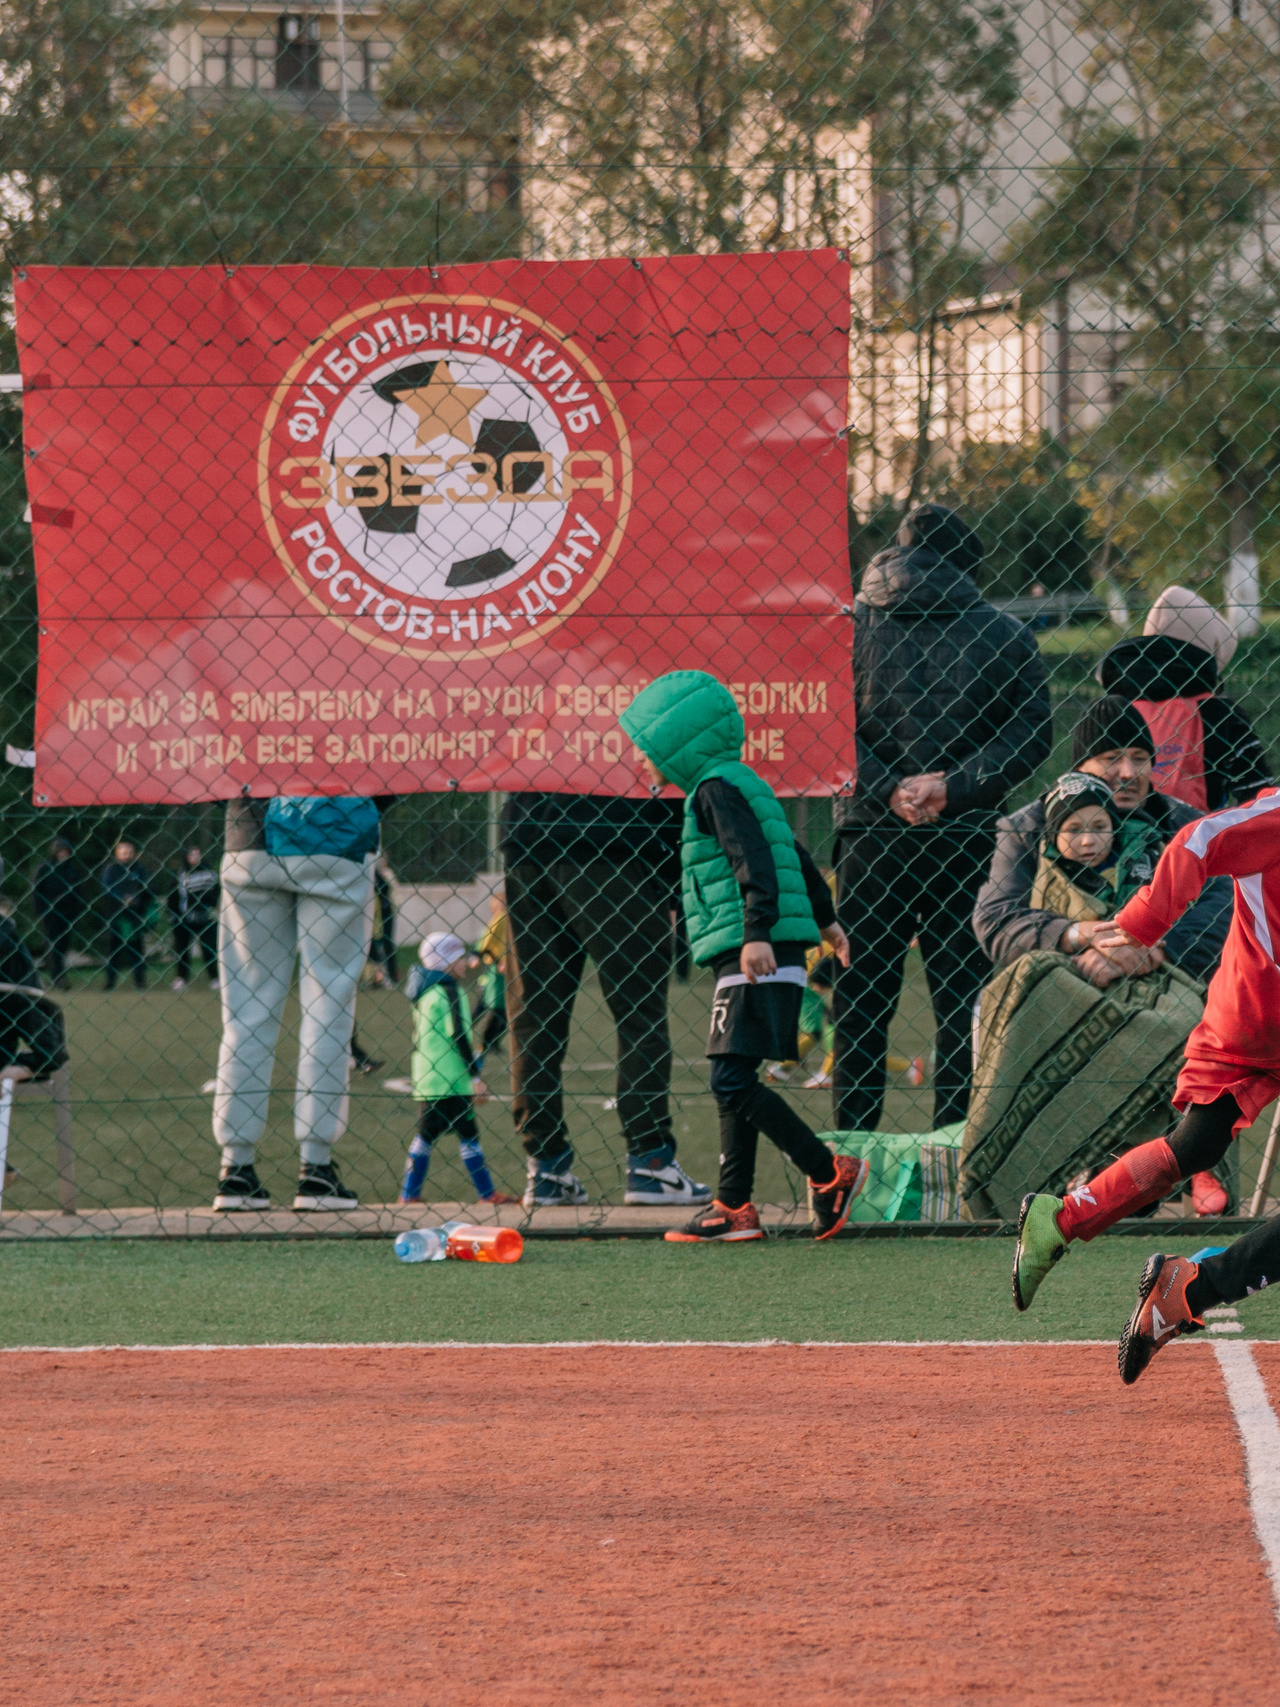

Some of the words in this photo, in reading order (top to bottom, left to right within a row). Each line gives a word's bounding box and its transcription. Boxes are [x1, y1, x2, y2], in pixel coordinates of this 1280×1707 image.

[288, 312, 523, 442] ФУТБОЛЬНЫЙ
[522, 341, 601, 434] КЛУБ
[279, 450, 615, 509] ЗВЕЗДА
[290, 512, 600, 642] РОСТОВ-НА-ДОНУ
[68, 689, 169, 732] ИГРАЙ
[180, 691, 220, 723] ЗА
[230, 689, 383, 722] ЭМБЛЕМУ
[392, 688, 436, 720] НА
[447, 684, 544, 718] ГРУДИ
[117, 742, 138, 774] И
[150, 733, 247, 771] ТОГДА
[257, 734, 314, 765] ВСЕ
[325, 729, 495, 764] ЗАПОМНЯТ
[507, 728, 553, 765] ТО,
[564, 730, 622, 763] ЧТО
